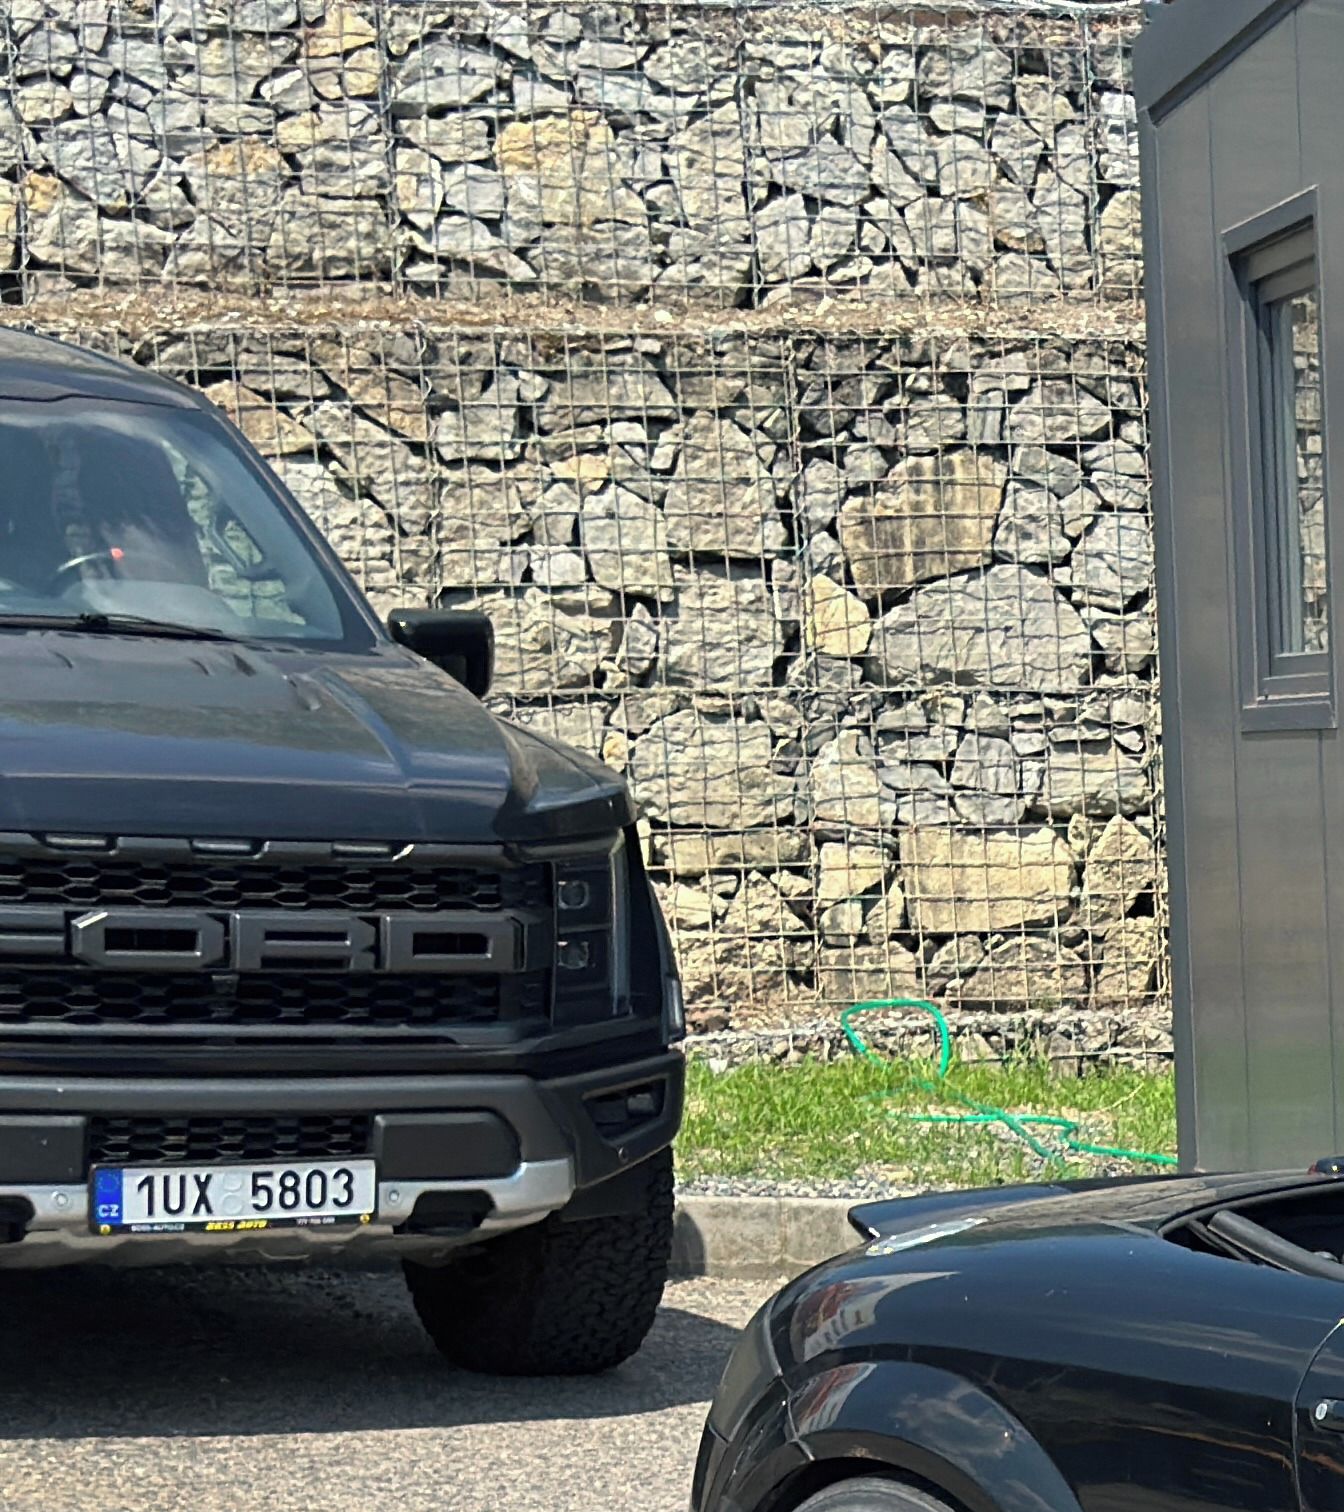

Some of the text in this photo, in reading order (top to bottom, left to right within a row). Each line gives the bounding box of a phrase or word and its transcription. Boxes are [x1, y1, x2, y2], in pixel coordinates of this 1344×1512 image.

[136, 1168, 354, 1217] 1UX 5803
[99, 1204, 119, 1218] CZ
